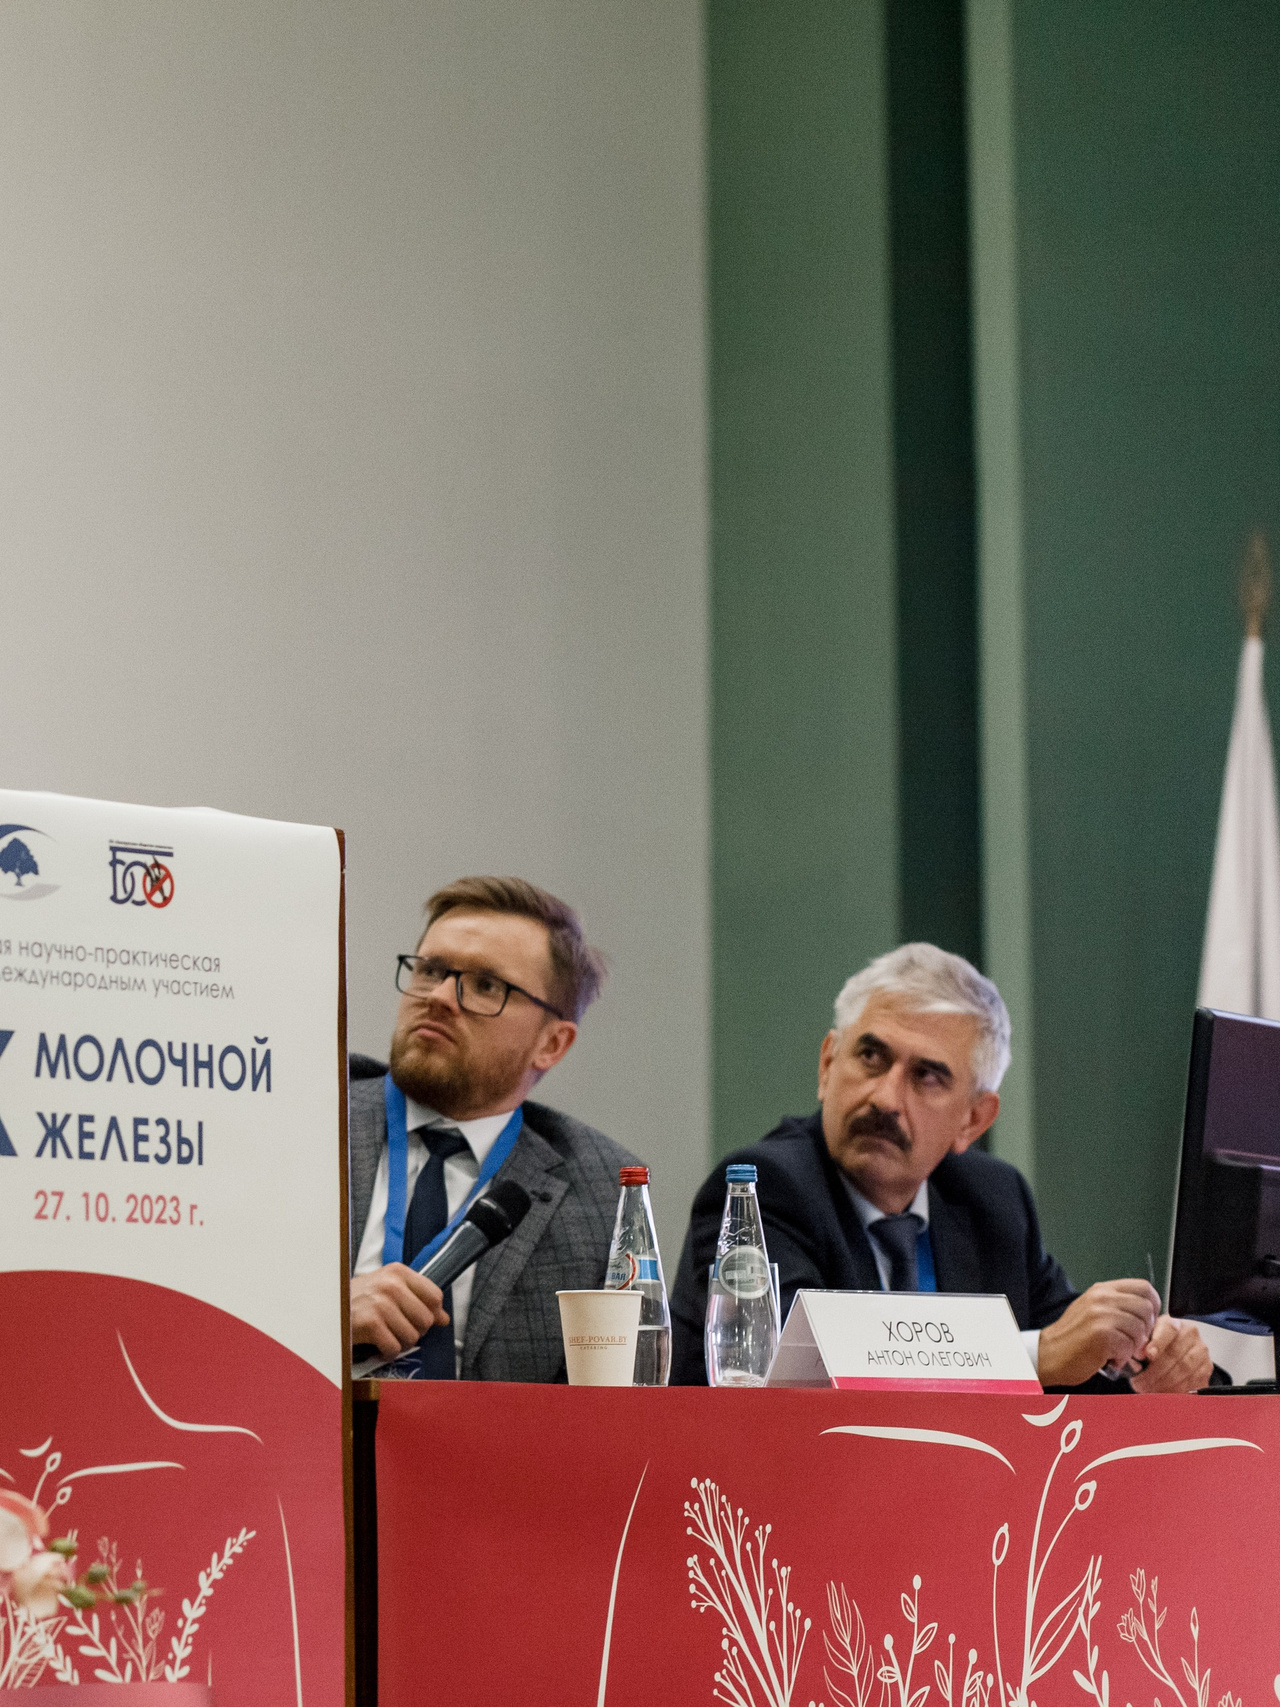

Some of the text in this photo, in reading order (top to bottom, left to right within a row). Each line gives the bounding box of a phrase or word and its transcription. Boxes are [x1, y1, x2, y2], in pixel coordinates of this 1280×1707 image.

[18, 940, 220, 973] научно-практическая
[152, 977, 235, 1000] участием
[34, 1032, 271, 1093] МОЛОЧНОЙ
[35, 1111, 203, 1166] ЖЕЛЕЗЫ
[34, 1189, 204, 1226] 27. 10. 2023 г.
[882, 1320, 955, 1344] ХОРОВ
[867, 1350, 993, 1369] АНТОН ОЛЕГОВИЧ
